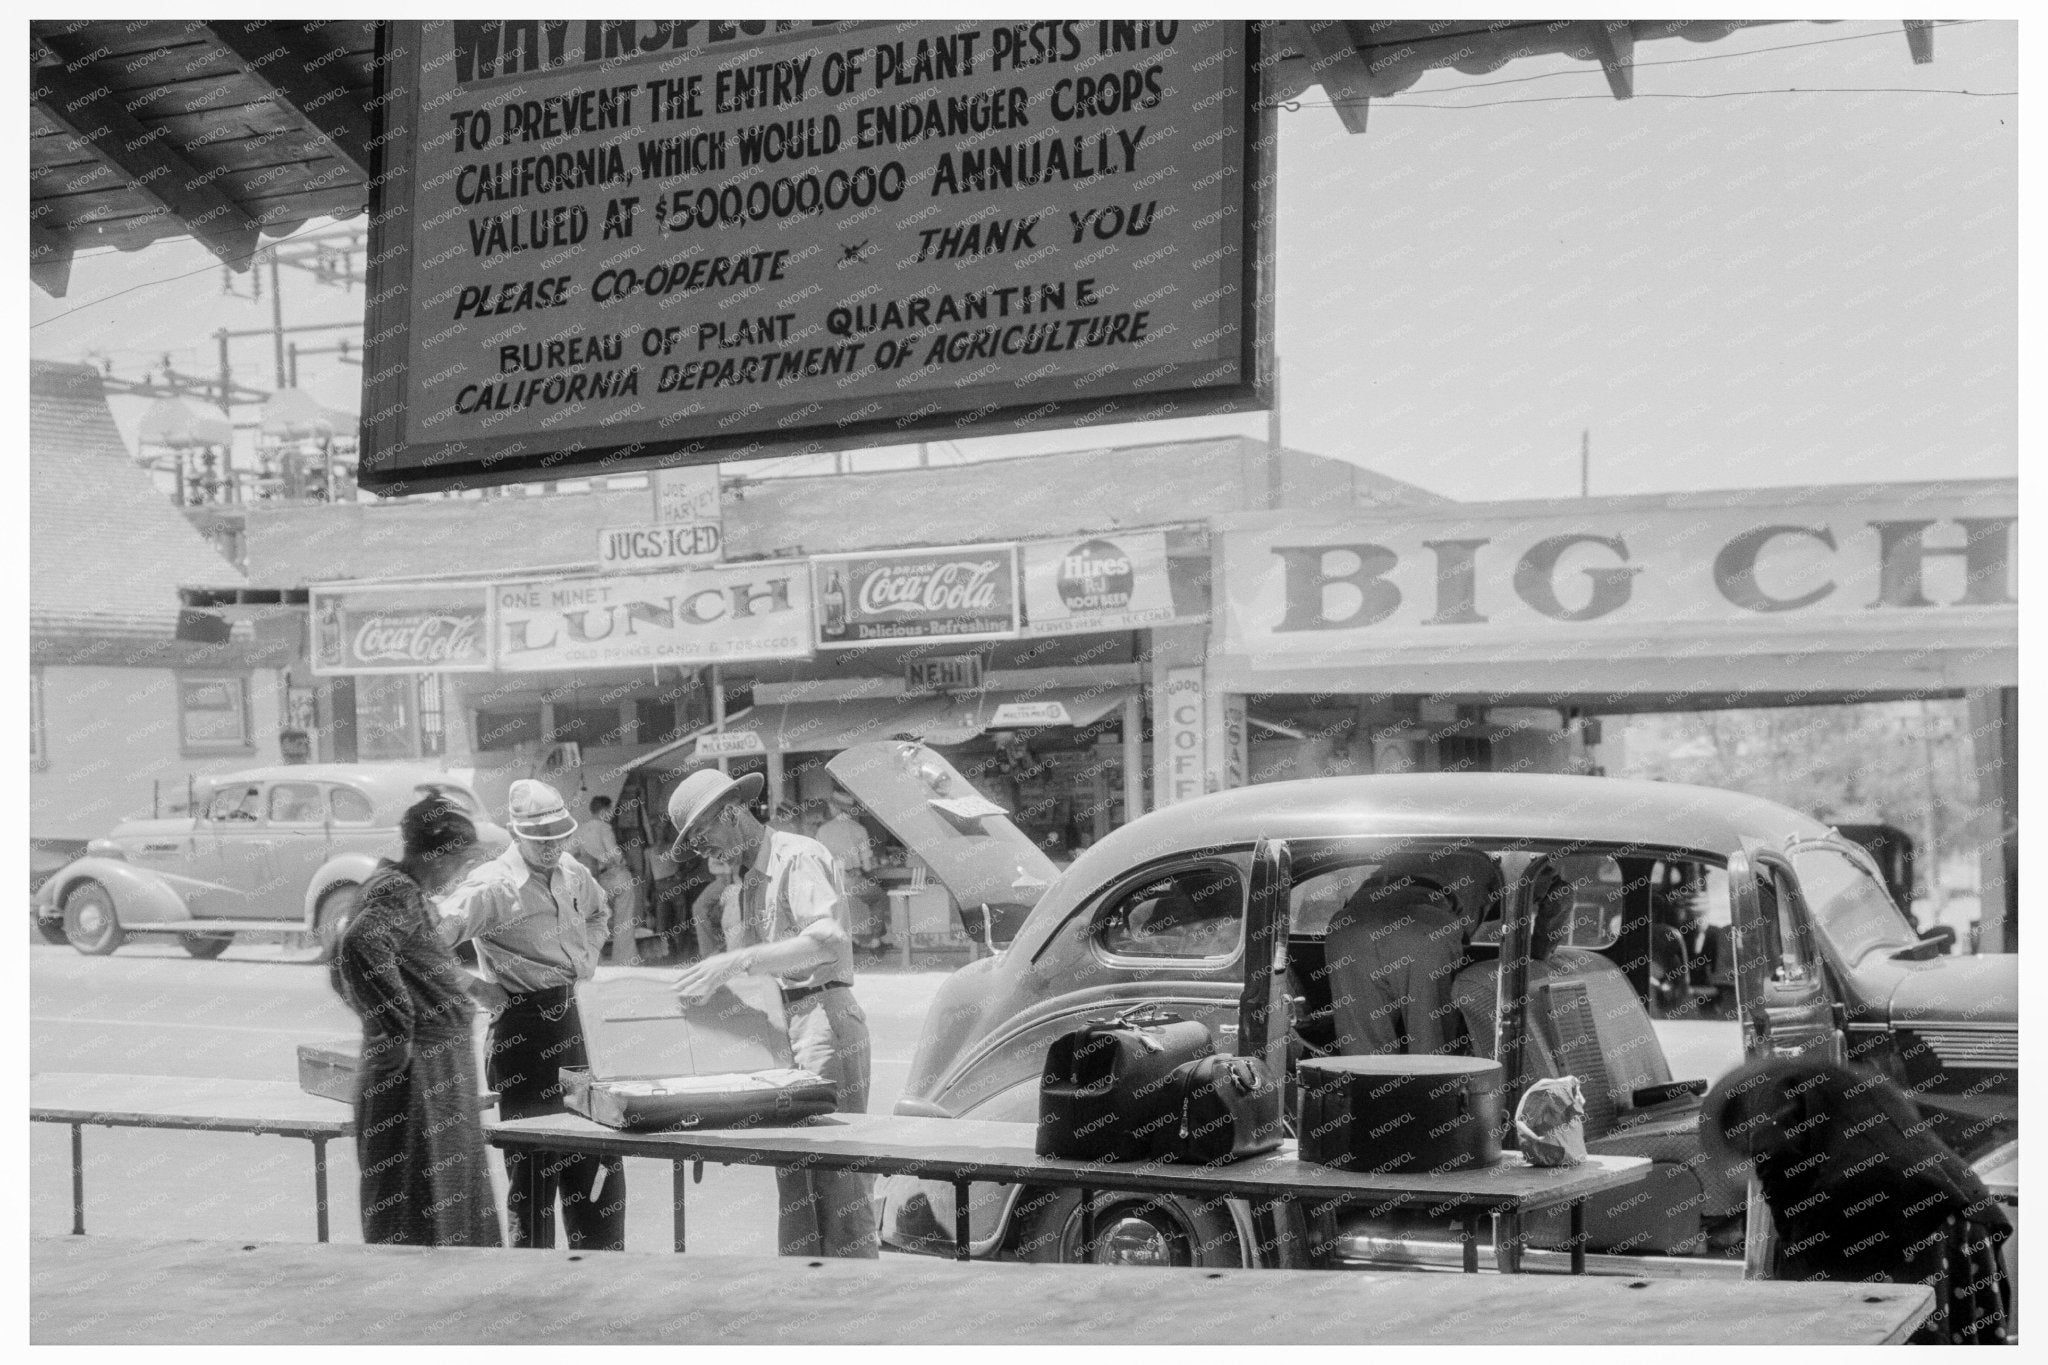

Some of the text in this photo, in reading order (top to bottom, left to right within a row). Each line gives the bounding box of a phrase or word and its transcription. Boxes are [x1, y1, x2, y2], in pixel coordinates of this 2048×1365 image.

[450, 109, 491, 153] TO
[503, 84, 638, 146] PREVENT
[646, 74, 703, 123] THE
[716, 55, 812, 114] ENTRY
[822, 48, 864, 97] OF
[875, 31, 980, 89] PLANT
[992, 20, 1081, 72] PESTS
[1099, 20, 1179, 55] INTO
[455, 65, 1163, 205] CALIFORNIA, WHICH WOULD ENDANGER CROPS
[468, 125, 1147, 257] VALUED AT $500,000,000 ANNUALLY
[453, 200, 1158, 320] PLEASE CO-OPERATE THANK YOU
[455, 310, 1150, 415] CALIFORNIA DEPARTMENT OF AGRICULTURE
[500, 277, 1100, 373] BUREAU OF PLANT QUARANTINE
[502, 586, 613, 608] ONE MINET
[859, 560, 1000, 614] Coca-Cola
[1064, 549, 1131, 579] Hires
[1270, 516, 2018, 634] BIG CH
[353, 614, 478, 662] Coca-Cola
[505, 578, 794, 654] LUNCH
[909, 660, 963, 686] NEHI
